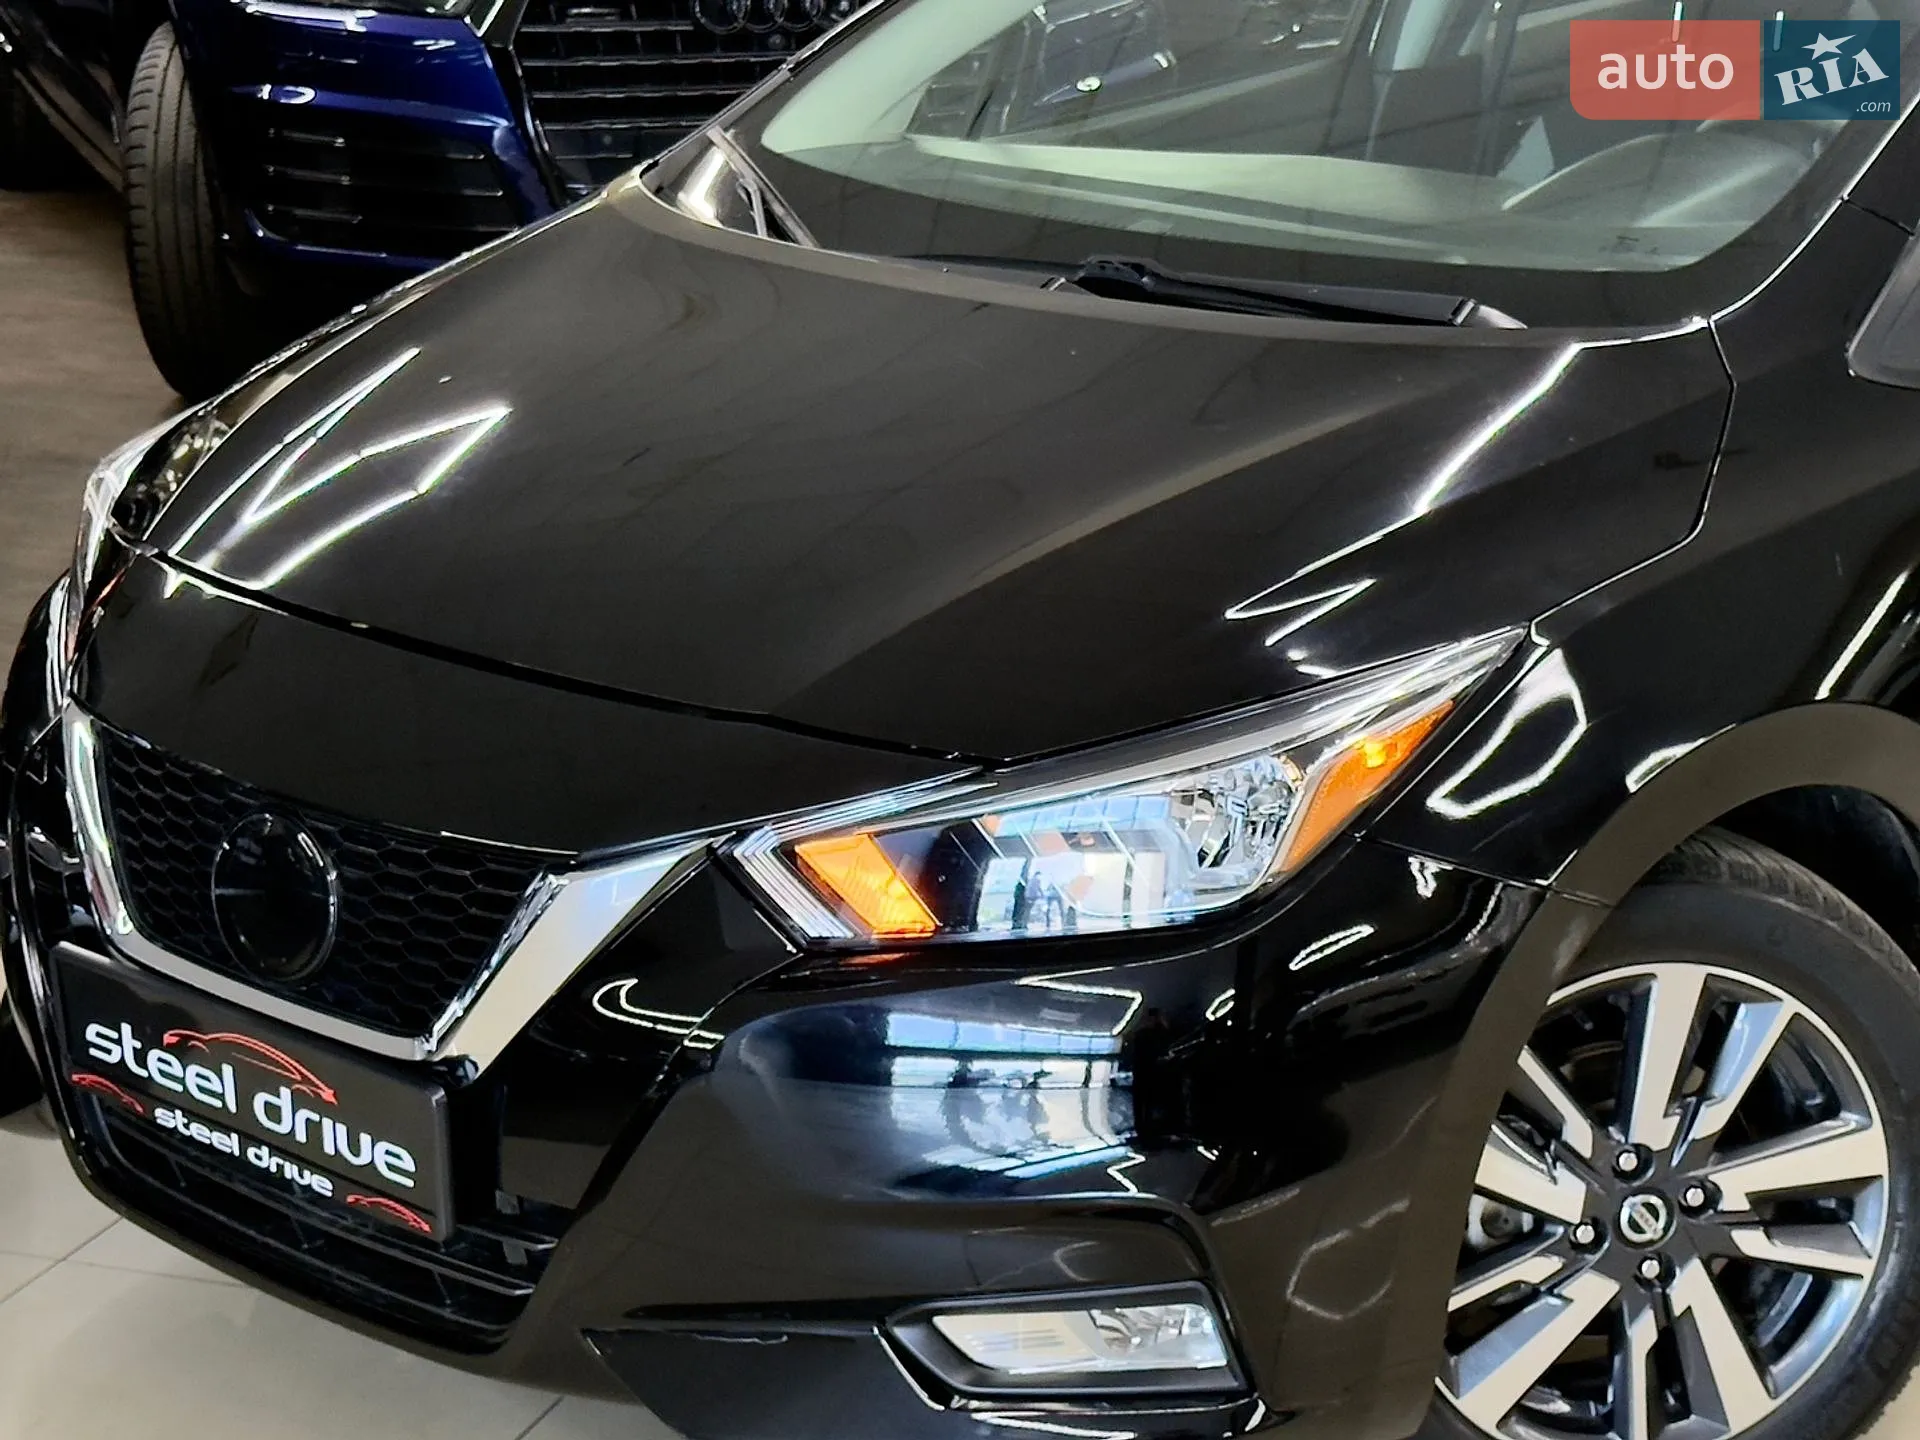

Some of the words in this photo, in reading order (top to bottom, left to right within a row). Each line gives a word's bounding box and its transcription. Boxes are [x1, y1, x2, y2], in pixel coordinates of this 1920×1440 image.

[85, 1022, 237, 1113] steel
[252, 1084, 416, 1188] drive
[154, 1107, 240, 1157] steel
[246, 1145, 334, 1198] drive
